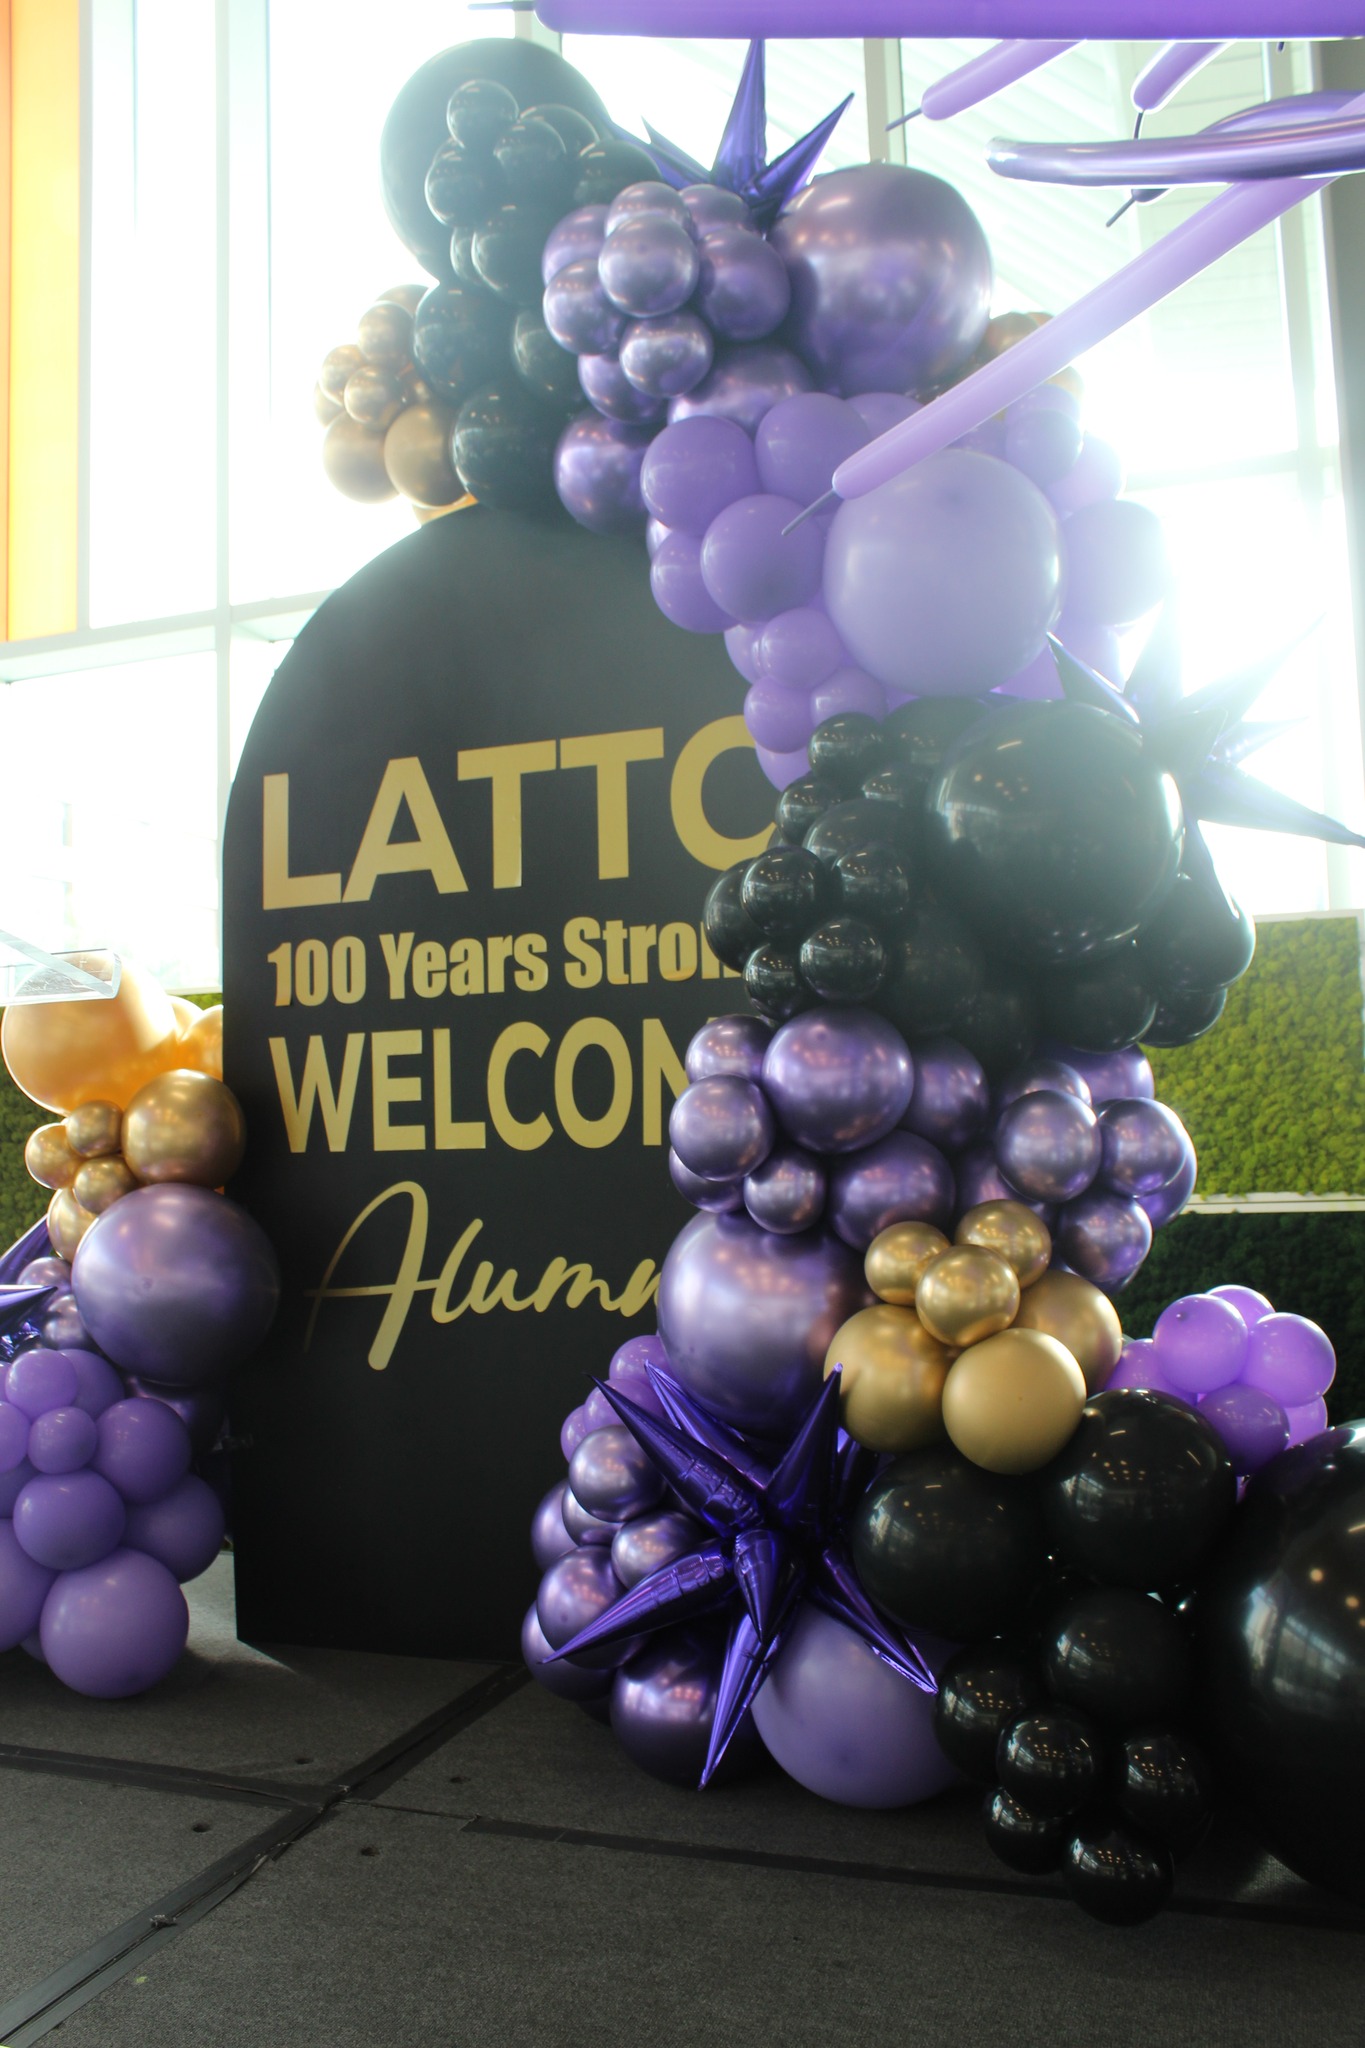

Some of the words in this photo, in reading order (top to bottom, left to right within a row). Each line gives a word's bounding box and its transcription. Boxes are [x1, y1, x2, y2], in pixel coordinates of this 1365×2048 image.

[261, 714, 777, 911] LATTC
[266, 935, 367, 1007] 100
[378, 921, 549, 1001] Years
